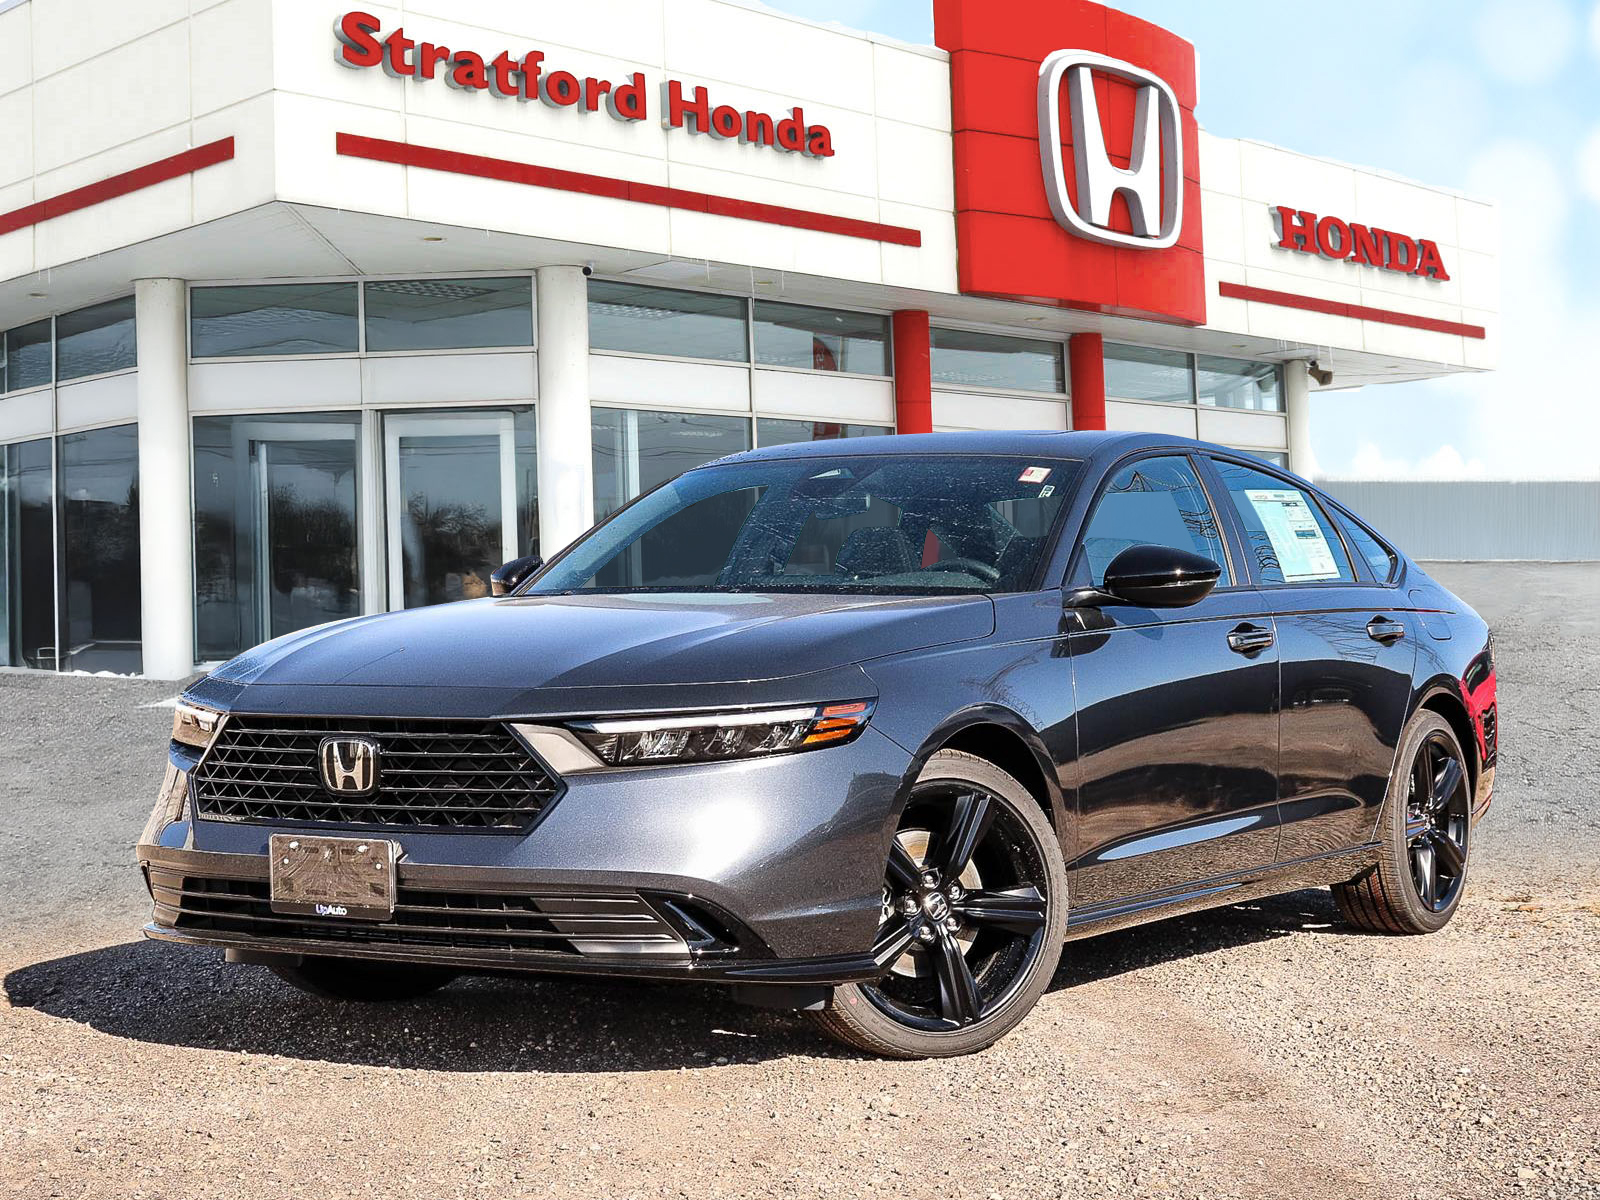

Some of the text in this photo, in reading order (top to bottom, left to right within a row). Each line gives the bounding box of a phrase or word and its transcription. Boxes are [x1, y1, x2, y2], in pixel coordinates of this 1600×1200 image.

[336, 11, 835, 158] Stratford Honda
[1272, 205, 1450, 282] HONDA
